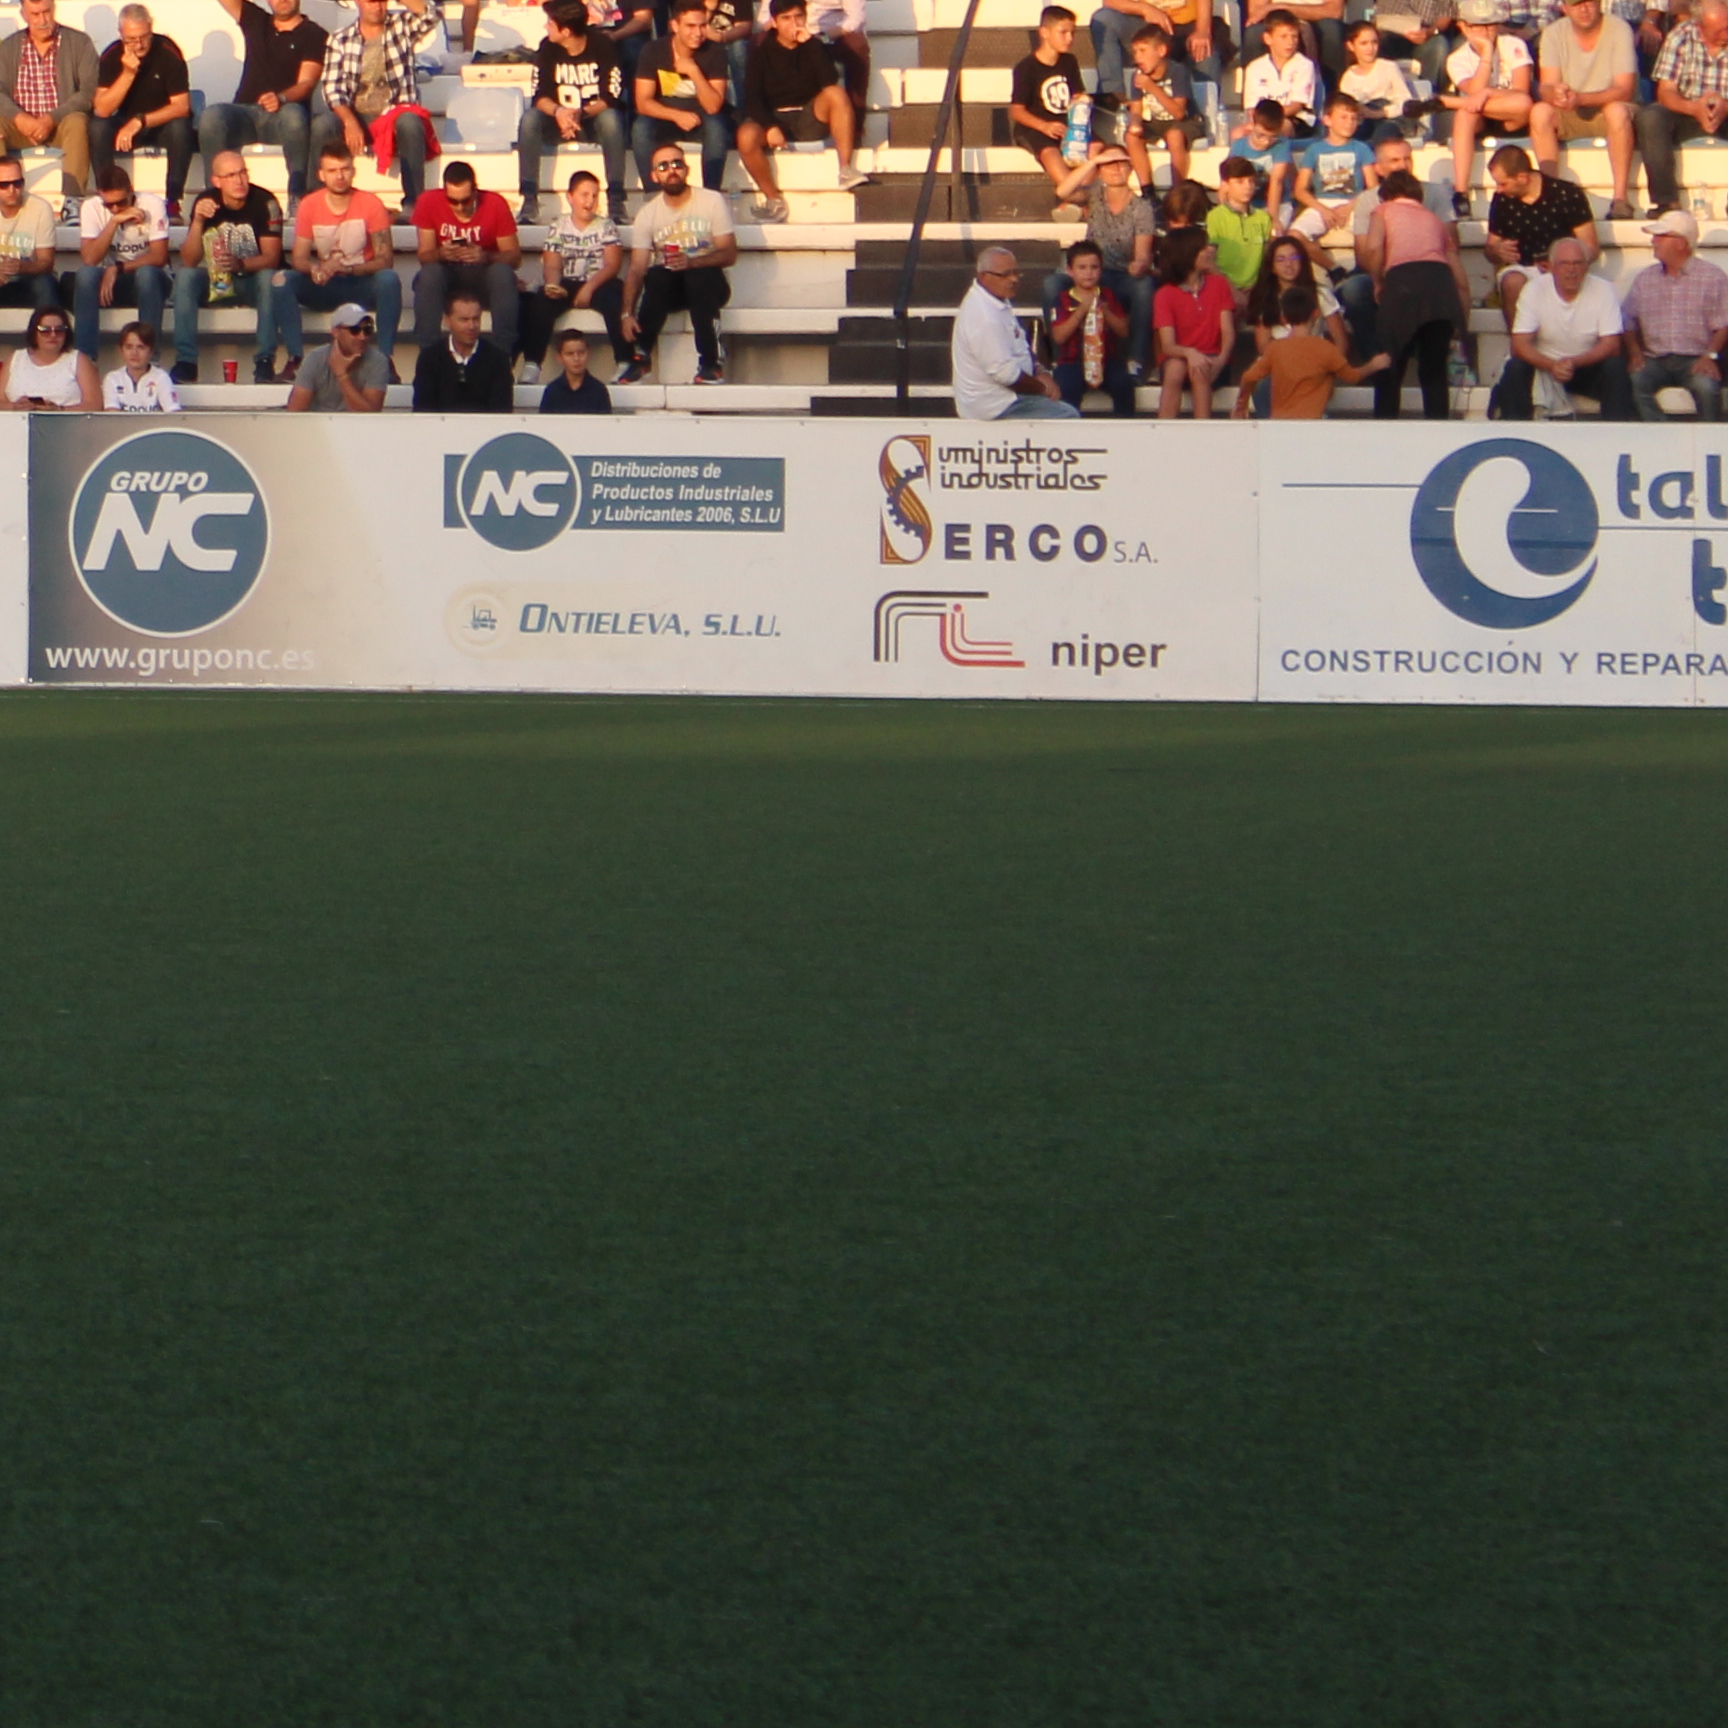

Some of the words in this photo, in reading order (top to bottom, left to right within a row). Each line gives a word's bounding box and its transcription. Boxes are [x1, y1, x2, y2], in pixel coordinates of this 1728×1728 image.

[556, 63, 599, 85] MARC
[110, 471, 209, 493] GRUPO
[590, 461, 699, 480] Distribuciones
[702, 463, 722, 480] de
[940, 466, 1108, 490] industriales
[469, 469, 569, 517] NC
[592, 483, 672, 502] Productos
[676, 484, 774, 503] Industriales
[590, 509, 602, 525] y
[605, 504, 693, 523] Lubricantes
[696, 505, 735, 526] 2006,
[739, 506, 781, 524] S.L.U
[82, 492, 255, 572] NC
[1113, 541, 1158, 564] S.A.
[702, 613, 782, 638] S.L.U.
[45, 642, 315, 677] www.gruponc.es
[1051, 634, 1167, 676] niper
[1281, 641, 1543, 675] CONSTRUCCIÓN
[1560, 652, 1579, 675] Y
